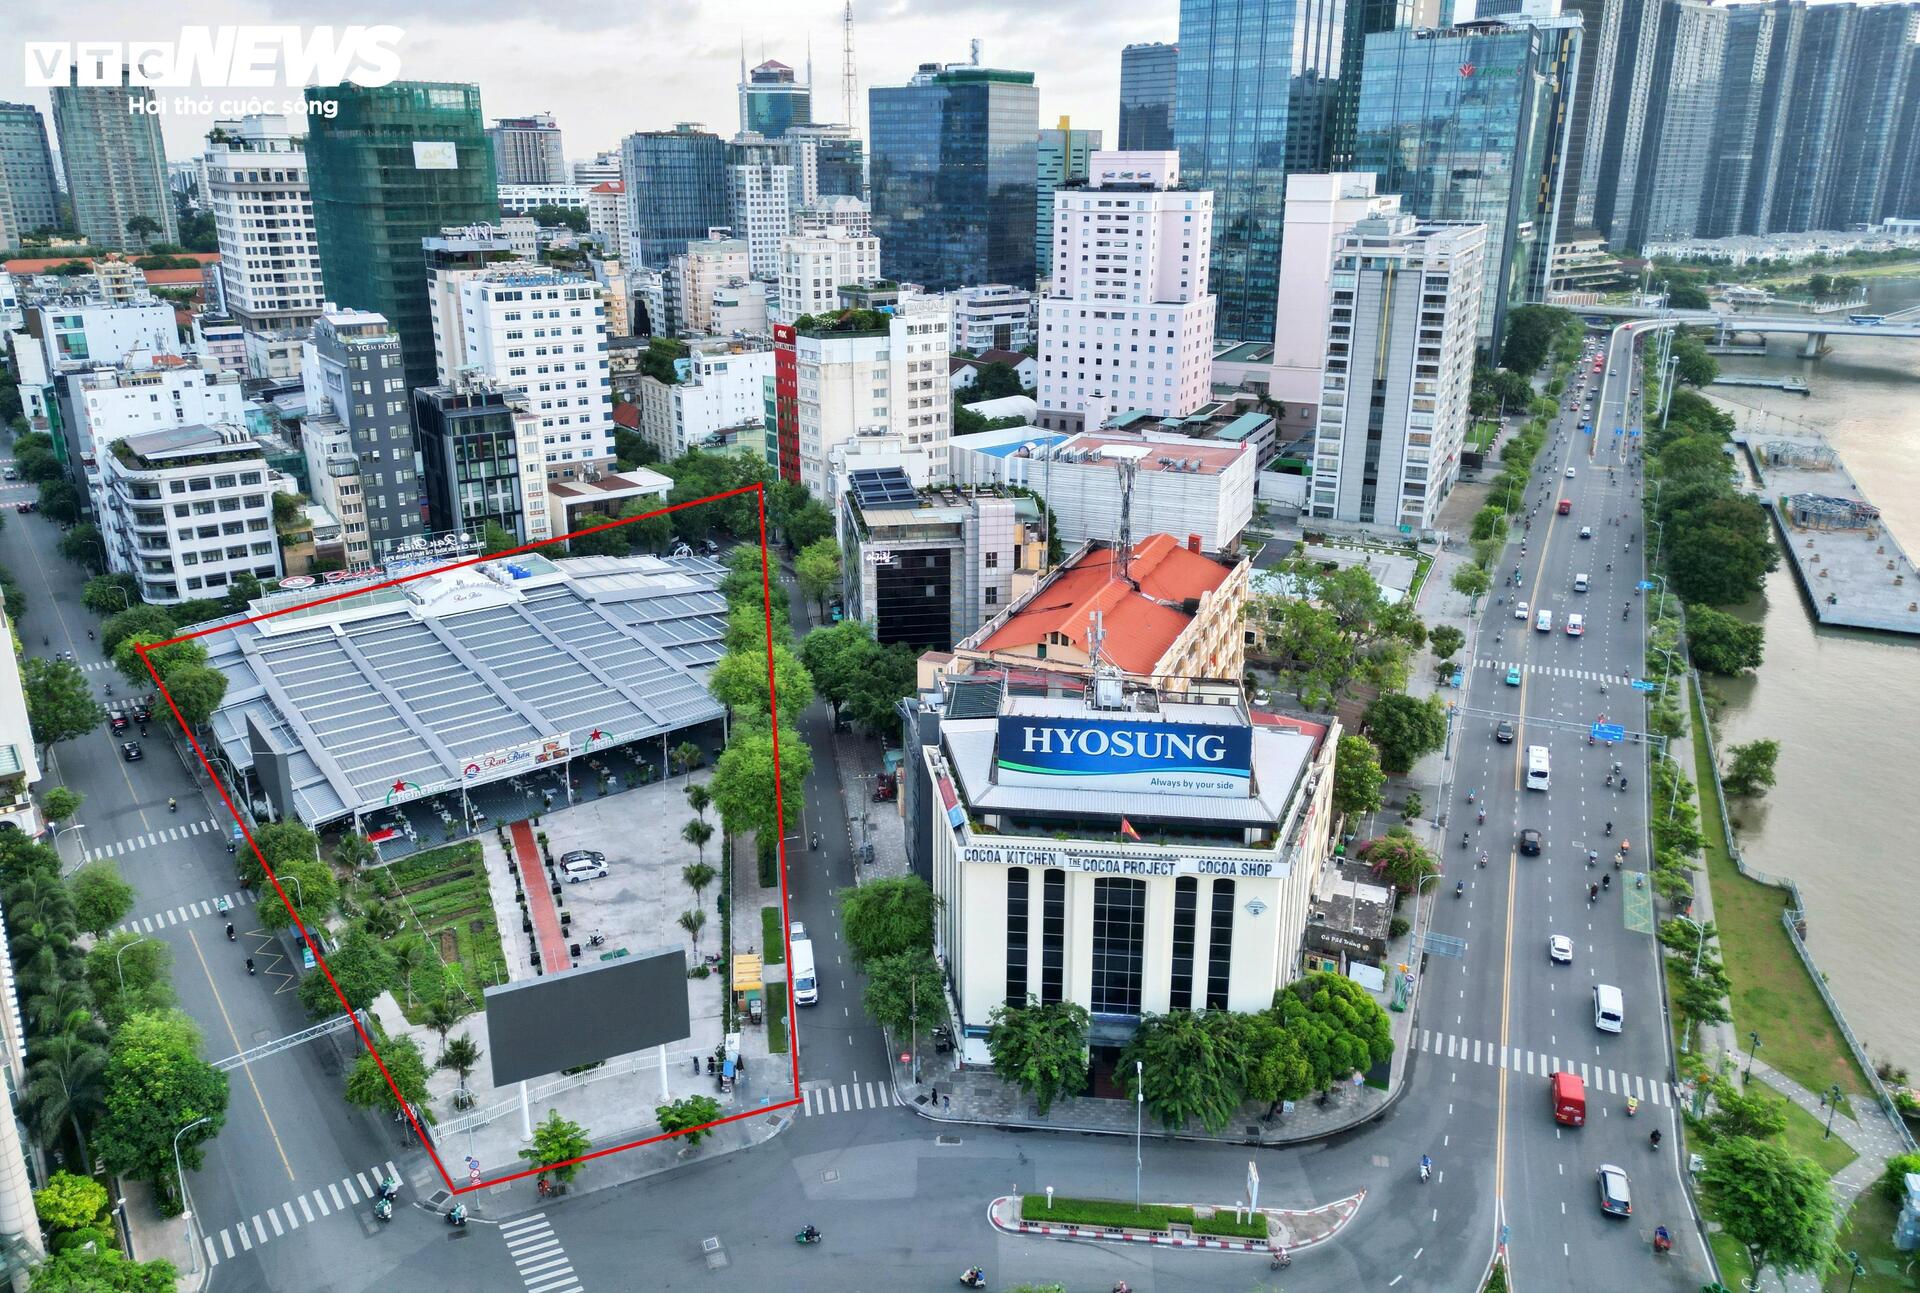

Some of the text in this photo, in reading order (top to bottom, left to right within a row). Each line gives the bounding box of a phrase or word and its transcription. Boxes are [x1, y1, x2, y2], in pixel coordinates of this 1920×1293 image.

[378, 342, 401, 350] HOTEL
[1022, 726, 1227, 761] HYOSUNG
[1150, 777, 1234, 790] Always by your side
[964, 848, 1056, 866] COCOA KITCHEN
[1069, 857, 1176, 875] THE COCOA PROJECT
[1198, 860, 1273, 877] COCOA SHOP
